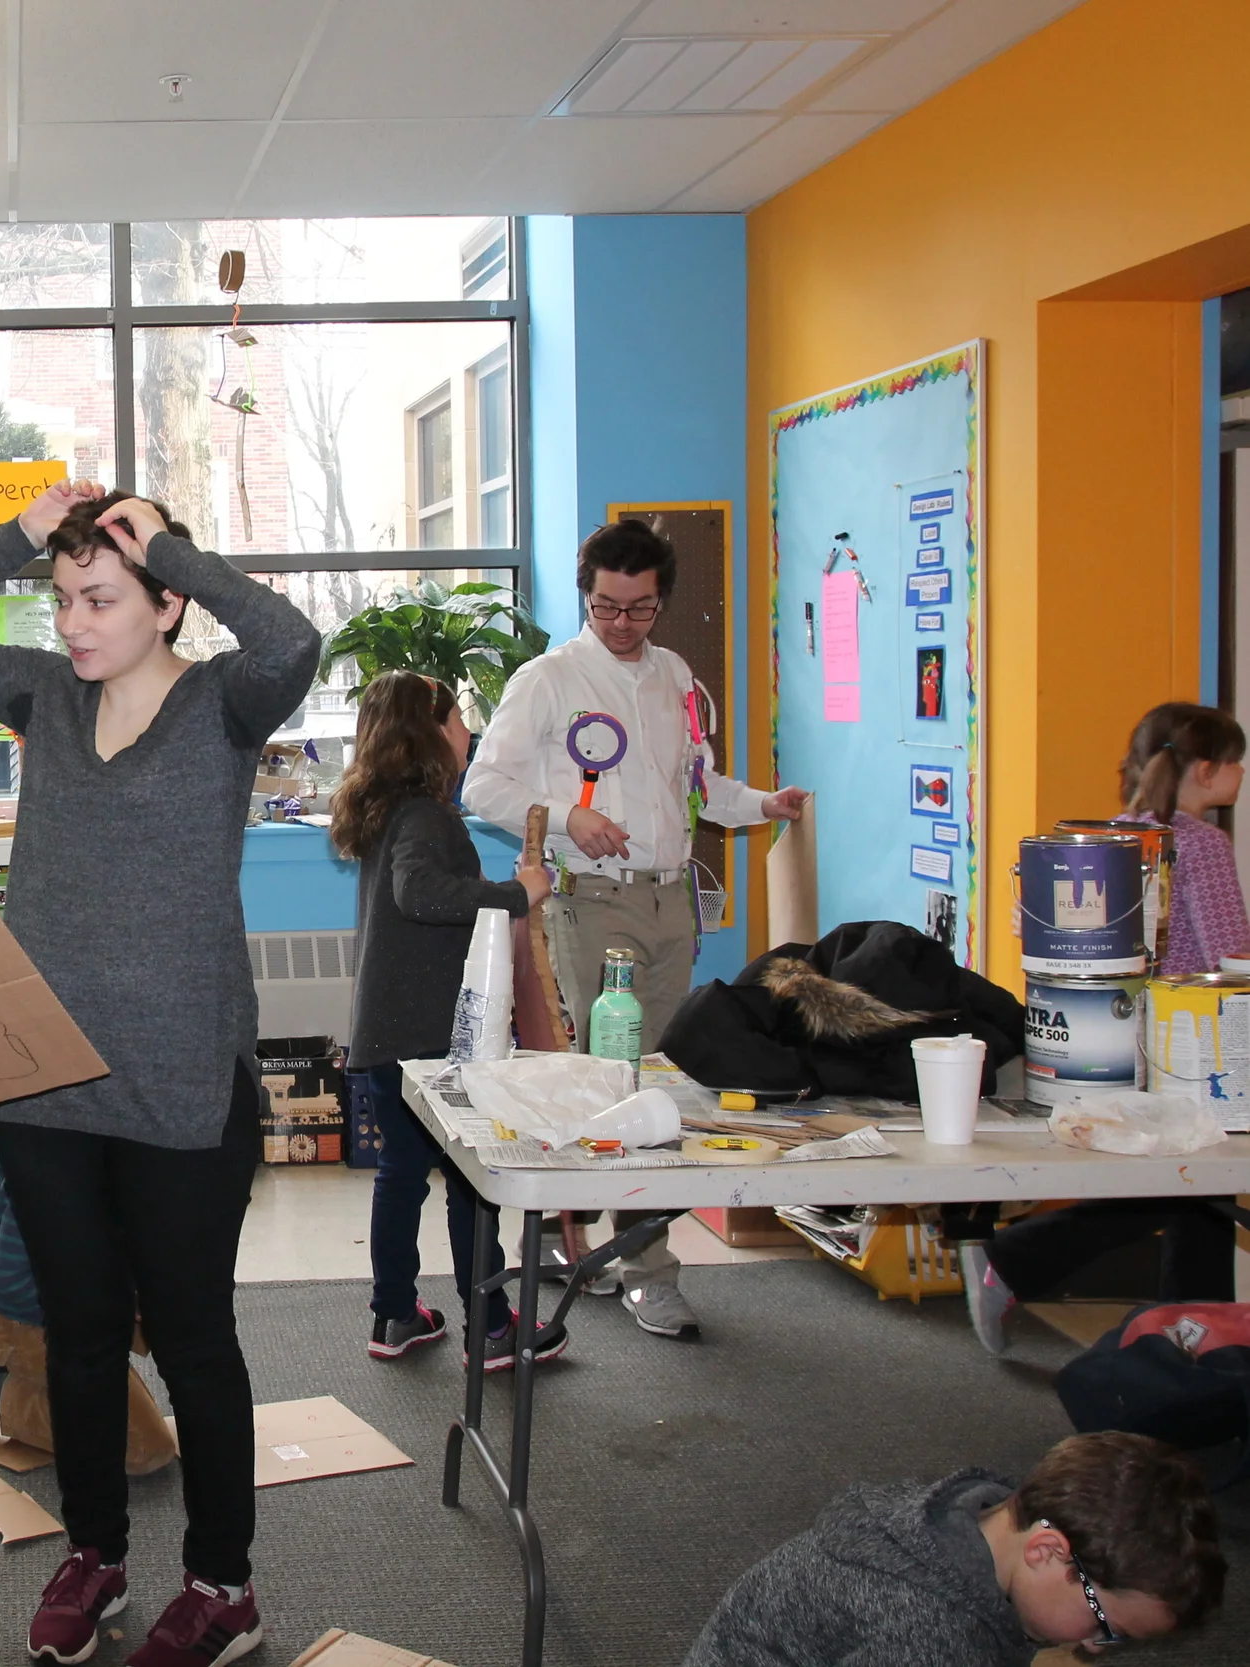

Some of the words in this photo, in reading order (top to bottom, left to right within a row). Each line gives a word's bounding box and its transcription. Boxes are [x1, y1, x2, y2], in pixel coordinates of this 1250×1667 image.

[1058, 900, 1102, 909] REAL
[1045, 1028, 1070, 1043] 500
[286, 1060, 313, 1069] MAPLE
